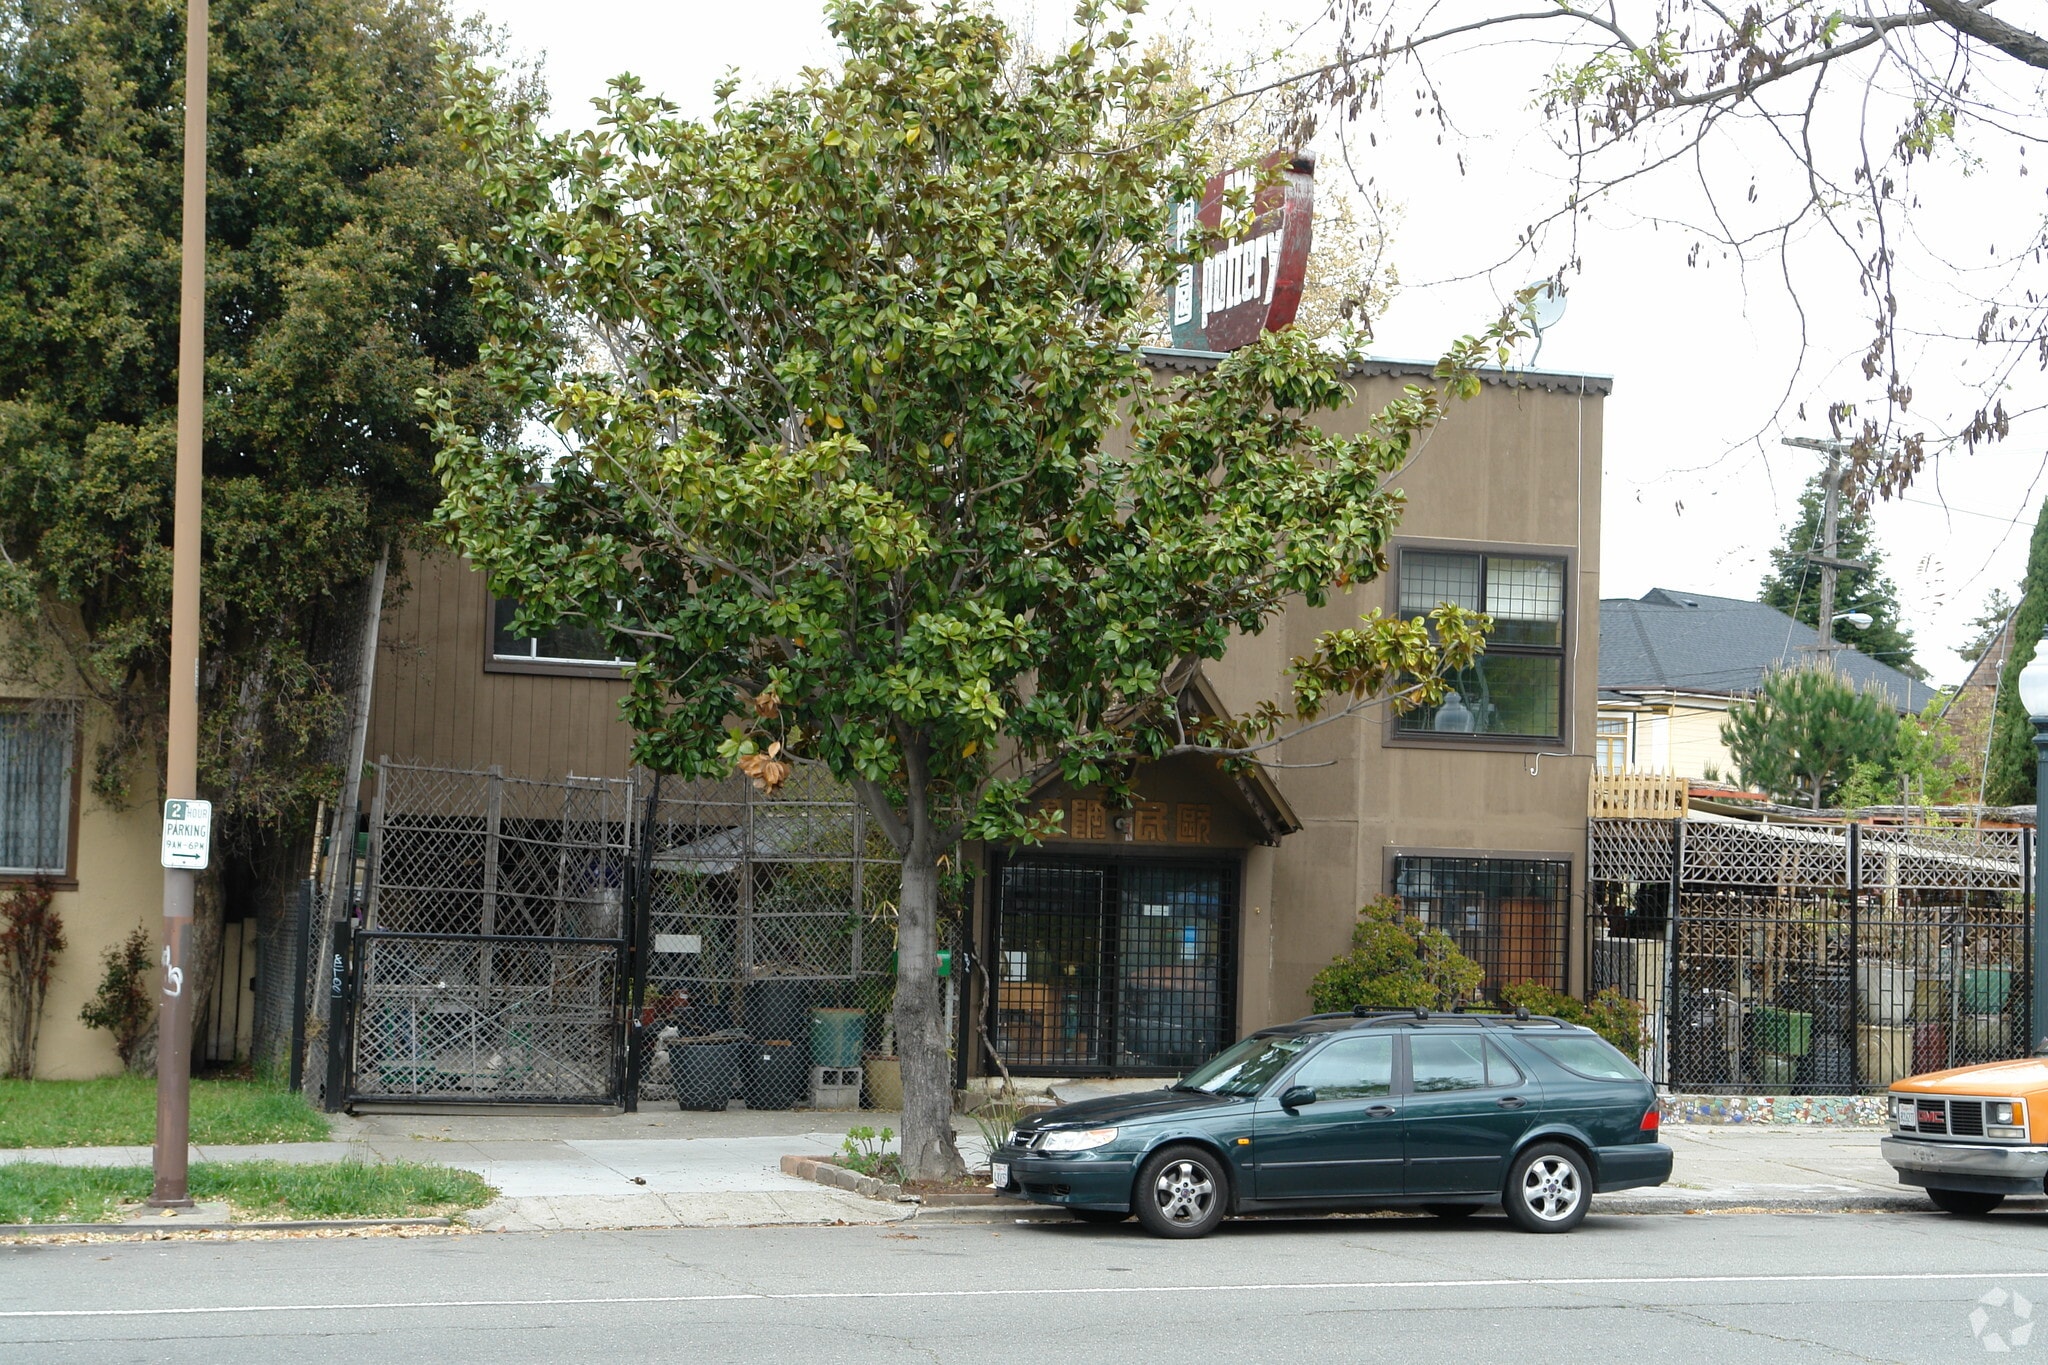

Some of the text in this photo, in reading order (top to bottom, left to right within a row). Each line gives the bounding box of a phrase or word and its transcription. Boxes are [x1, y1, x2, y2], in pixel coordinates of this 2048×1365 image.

[171, 803, 208, 819] 2 HOUR
[167, 823, 206, 838] PARKING
[1917, 1110, 1945, 1123] GMC
